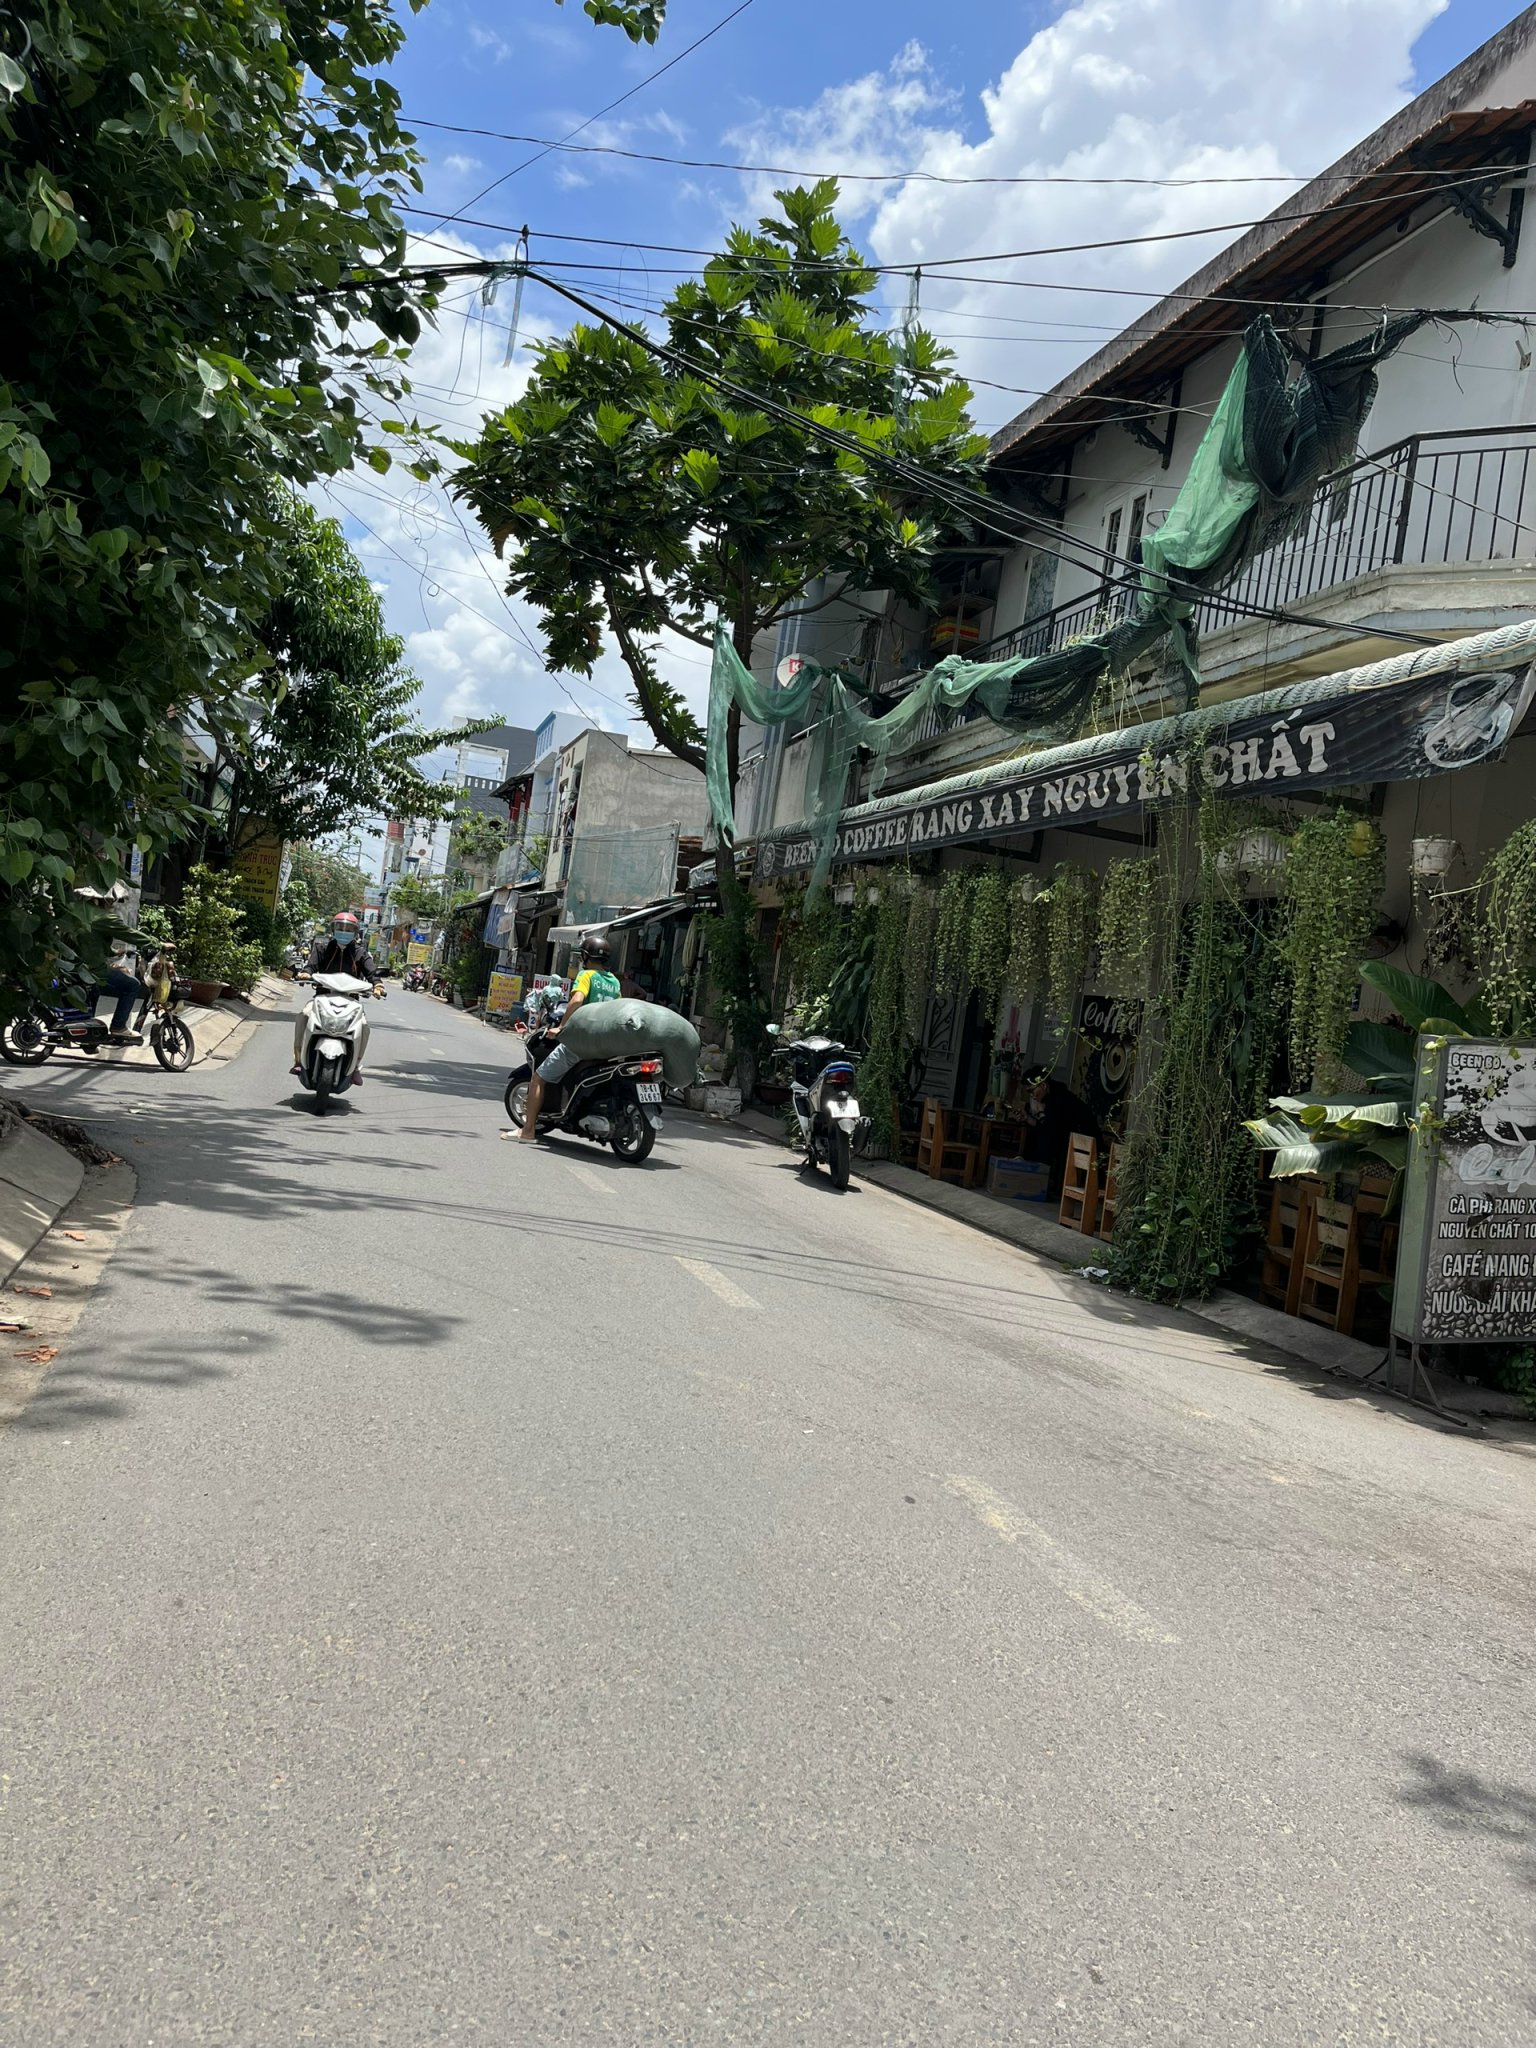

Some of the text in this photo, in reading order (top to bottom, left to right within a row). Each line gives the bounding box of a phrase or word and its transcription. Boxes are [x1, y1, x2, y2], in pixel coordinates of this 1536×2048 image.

[783, 838, 819, 868] BEEN
[843, 815, 909, 856] COFFEE
[910, 800, 973, 842] RANG
[977, 785, 1035, 830] XAY
[1200, 708, 1336, 788] CHẤT
[1084, 1001, 1138, 1034] Coffe
[1452, 1052, 1483, 1068] BEEN
[1449, 1194, 1466, 1214] CÀ
[1468, 1196, 1494, 1214] PH
[1494, 1197, 1526, 1214] RANG
[1489, 1217, 1521, 1239] CHẤT
[1442, 1249, 1483, 1277] CAFÉ
